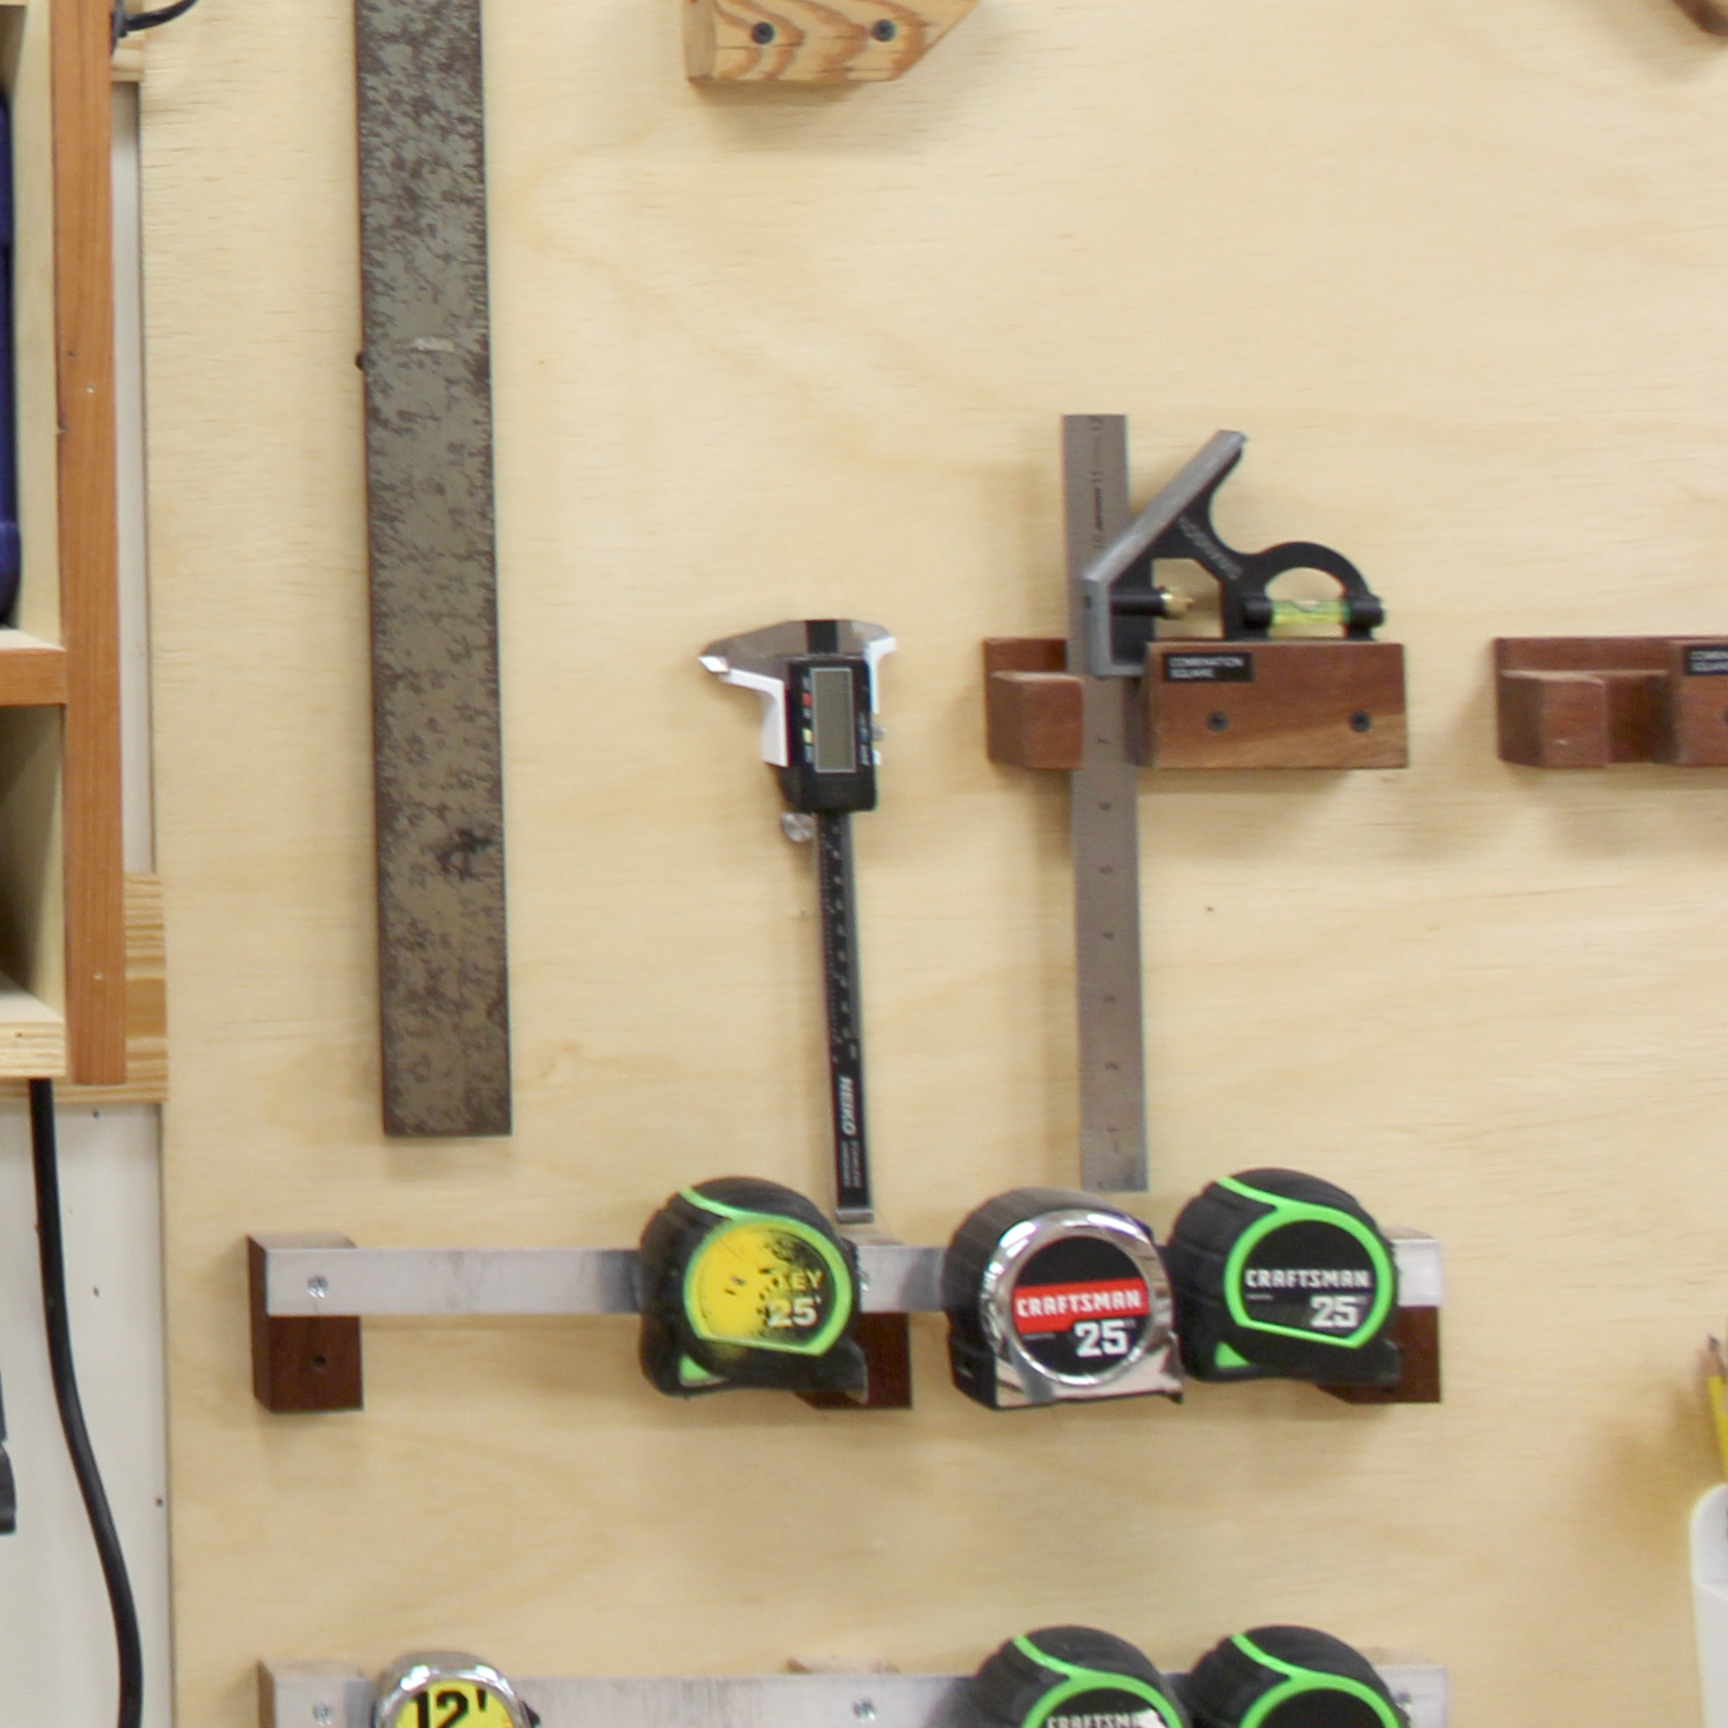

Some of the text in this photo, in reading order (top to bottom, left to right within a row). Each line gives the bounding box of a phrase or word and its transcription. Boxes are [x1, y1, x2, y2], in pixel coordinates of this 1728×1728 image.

[1245, 1270, 1372, 1289] CRAFTSMAN
[1015, 1290, 1142, 1318] CRAFTSMAN
[1310, 1295, 1359, 1328] 25
[1074, 1320, 1129, 1357] 25
[412, 1688, 487, 1728] 12'
